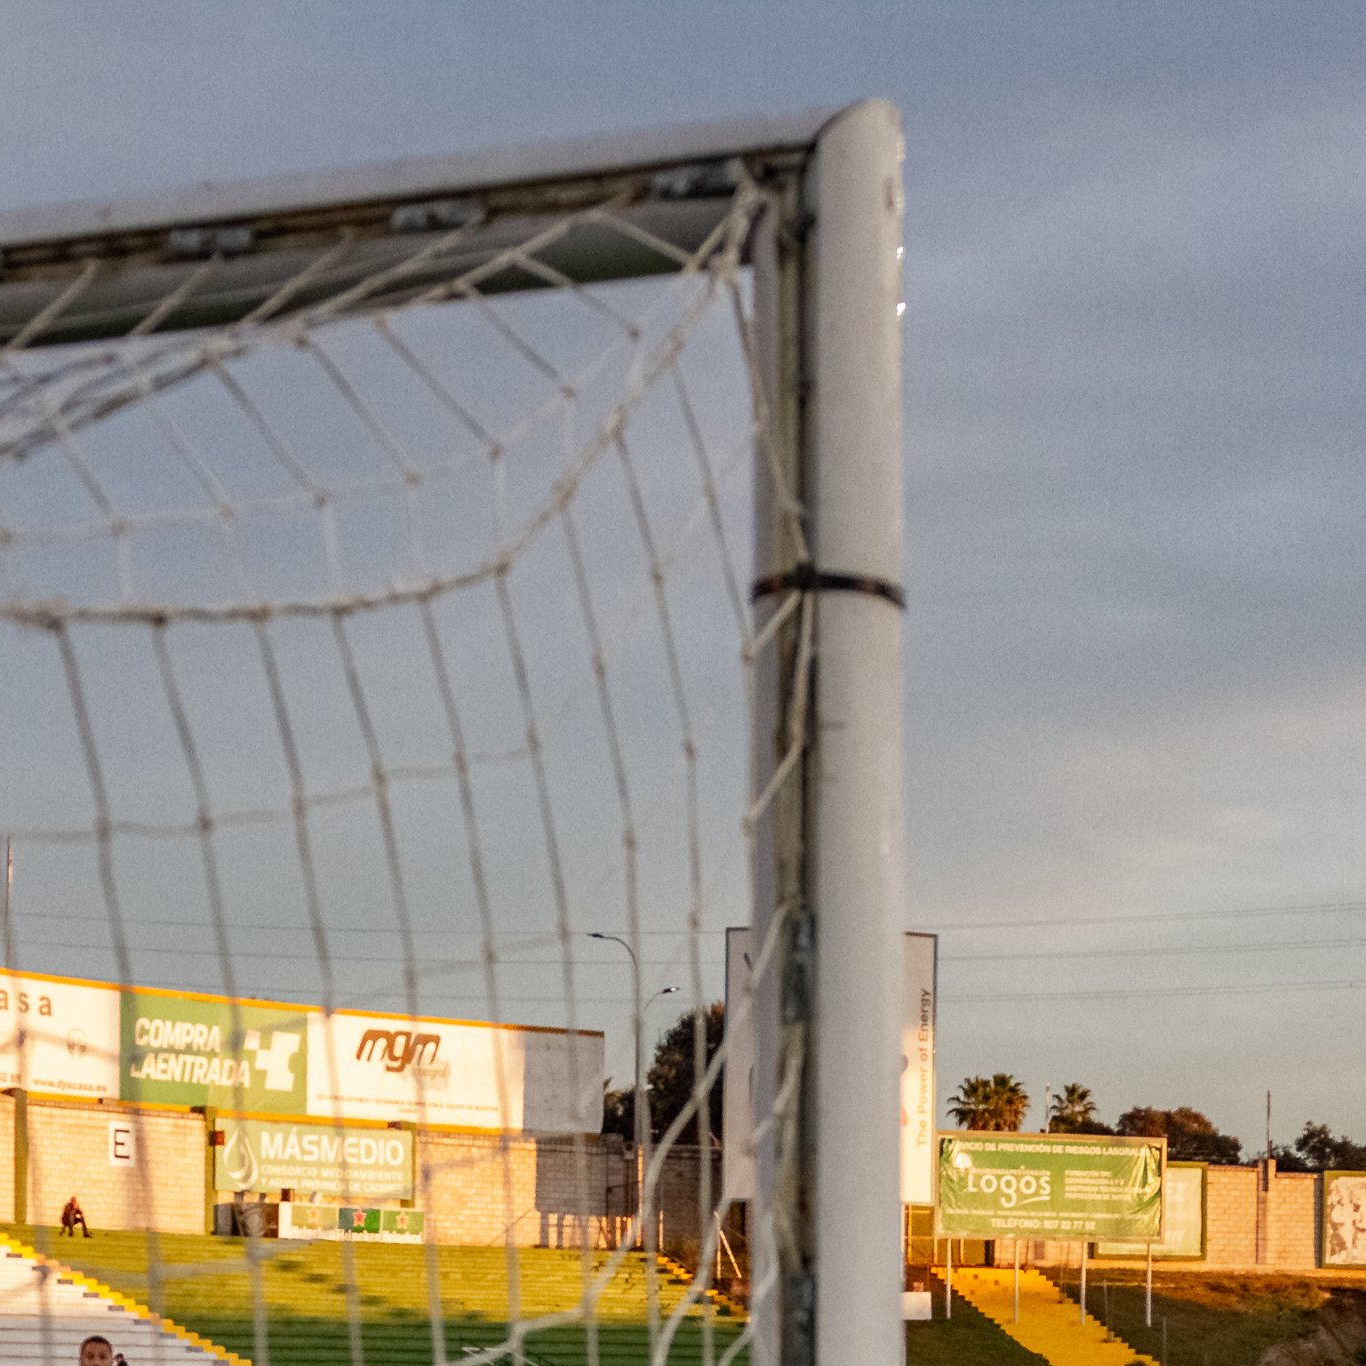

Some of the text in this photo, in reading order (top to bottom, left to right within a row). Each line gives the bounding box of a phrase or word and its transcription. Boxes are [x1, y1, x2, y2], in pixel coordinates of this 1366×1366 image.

[919, 987, 931, 1042] Energy
[134, 1017, 222, 1054] COMPRA
[355, 1027, 441, 1073] mgm
[114, 1130, 129, 1160] E
[260, 1127, 405, 1167] MÁSMEDIO
